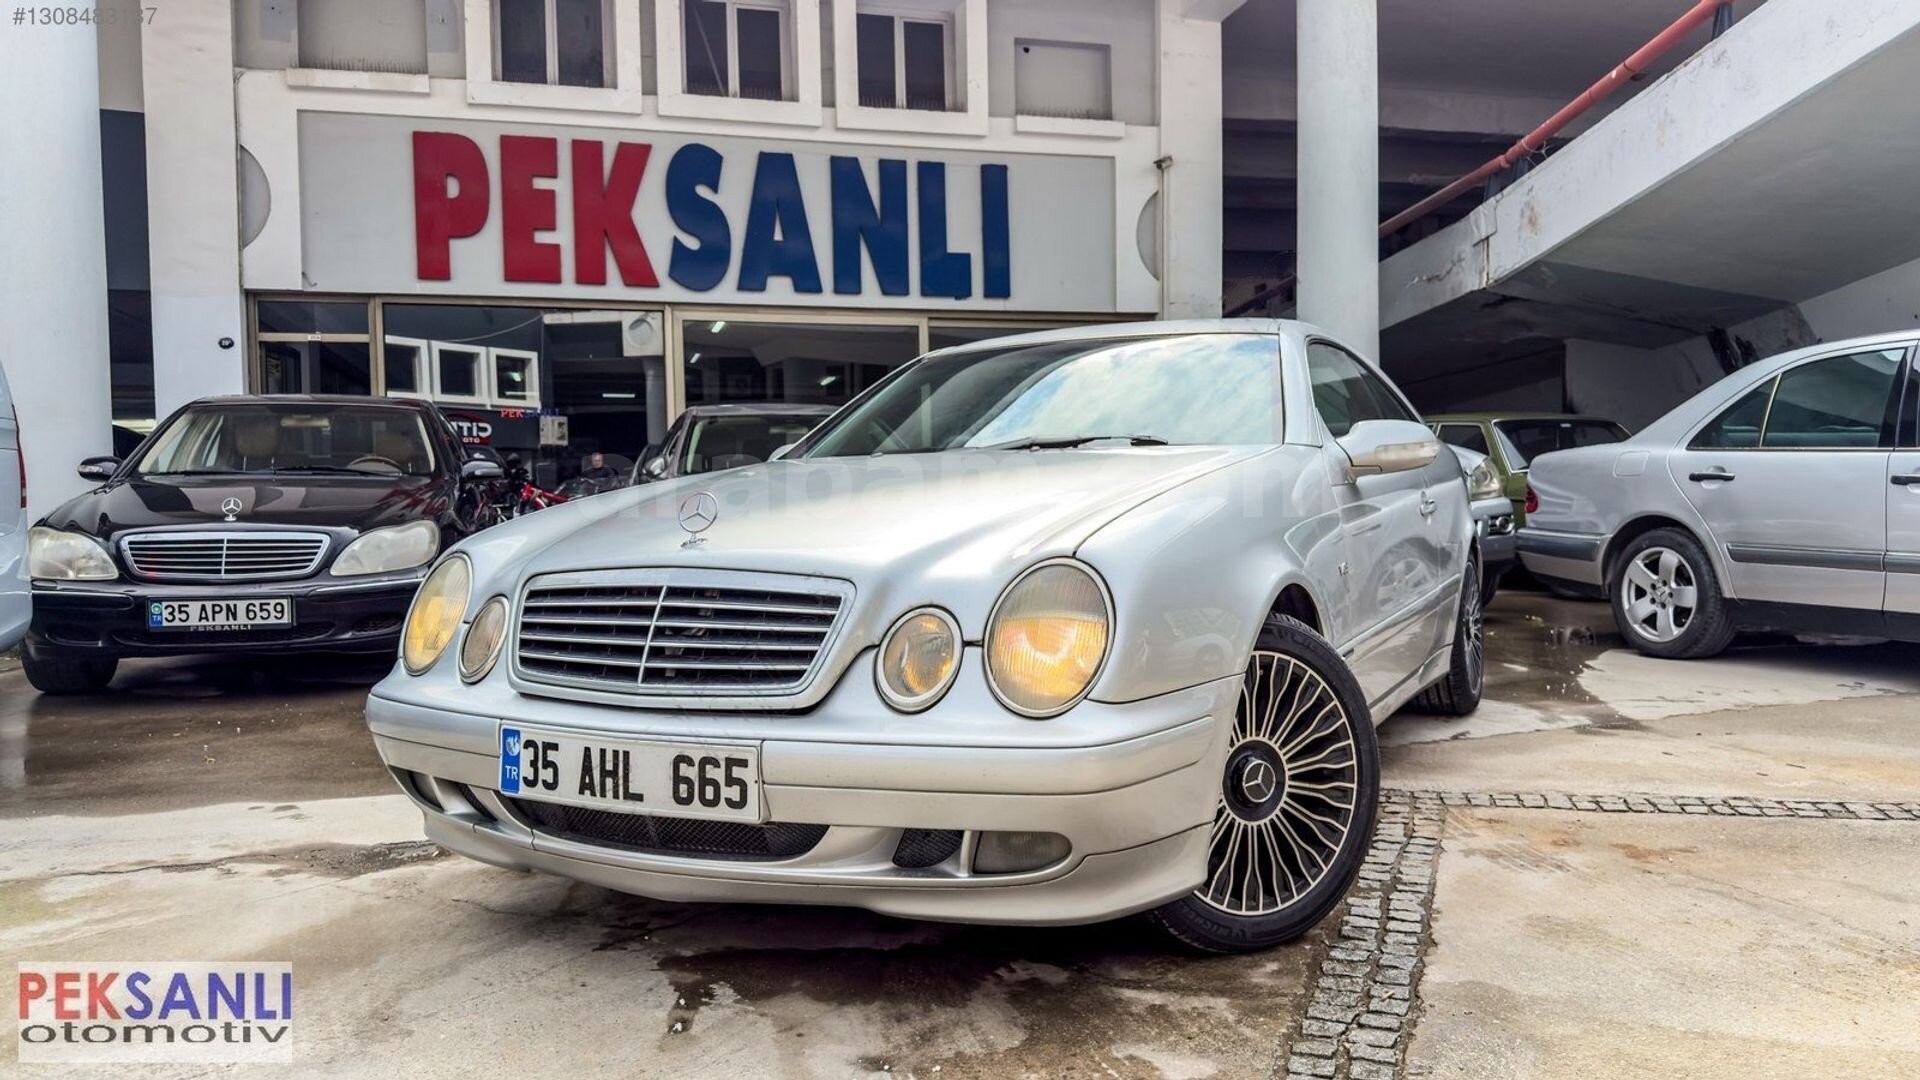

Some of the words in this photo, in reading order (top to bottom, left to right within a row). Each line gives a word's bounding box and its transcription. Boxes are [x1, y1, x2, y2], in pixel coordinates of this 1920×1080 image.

[412, 130, 1011, 299] PEKSANLI
[163, 604, 190, 623] 35
[198, 603, 237, 622] APN
[245, 602, 285, 621] 659
[505, 765, 518, 781] TR
[522, 739, 559, 791] 35
[578, 747, 644, 803] AHL
[672, 754, 748, 810] 665
